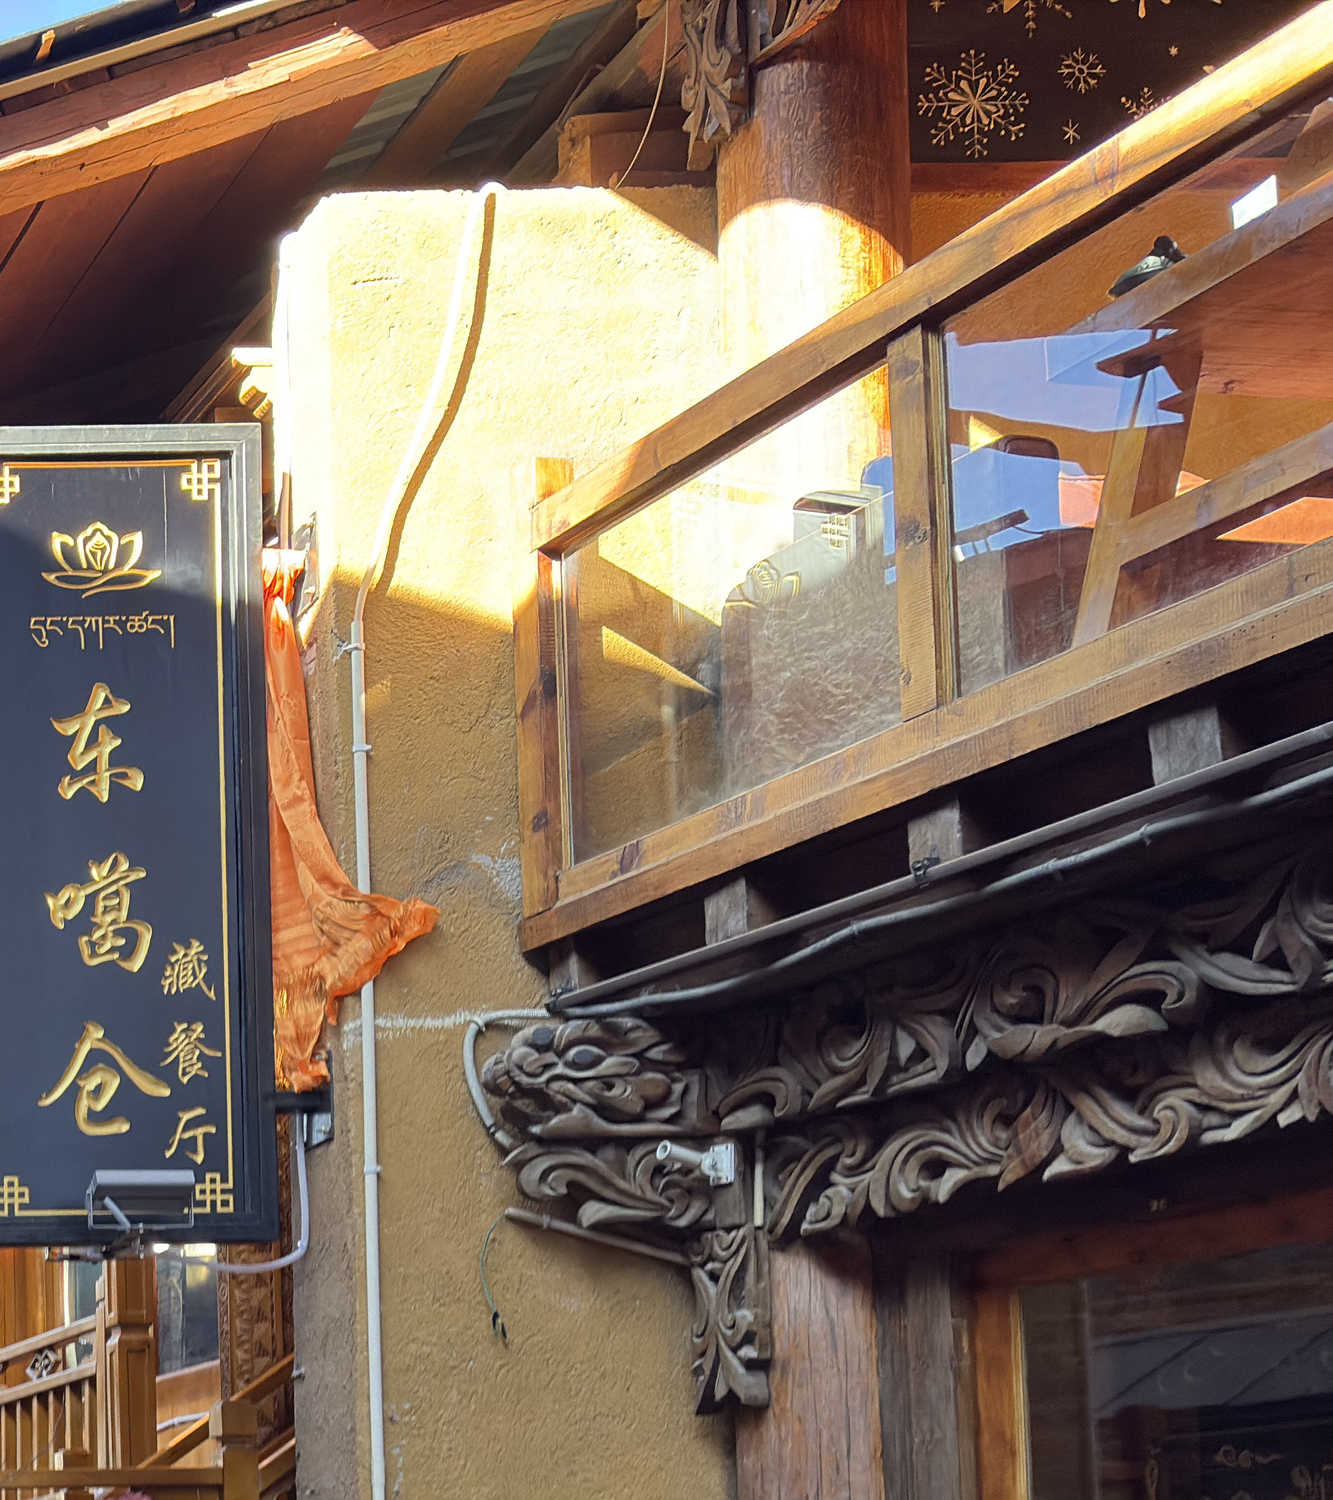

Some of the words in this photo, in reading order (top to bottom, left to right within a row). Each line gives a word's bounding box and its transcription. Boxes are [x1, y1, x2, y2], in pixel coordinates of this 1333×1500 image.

[37, 682, 171, 1136] 东噶仓
[161, 938, 221, 1164] 藏餐厅
